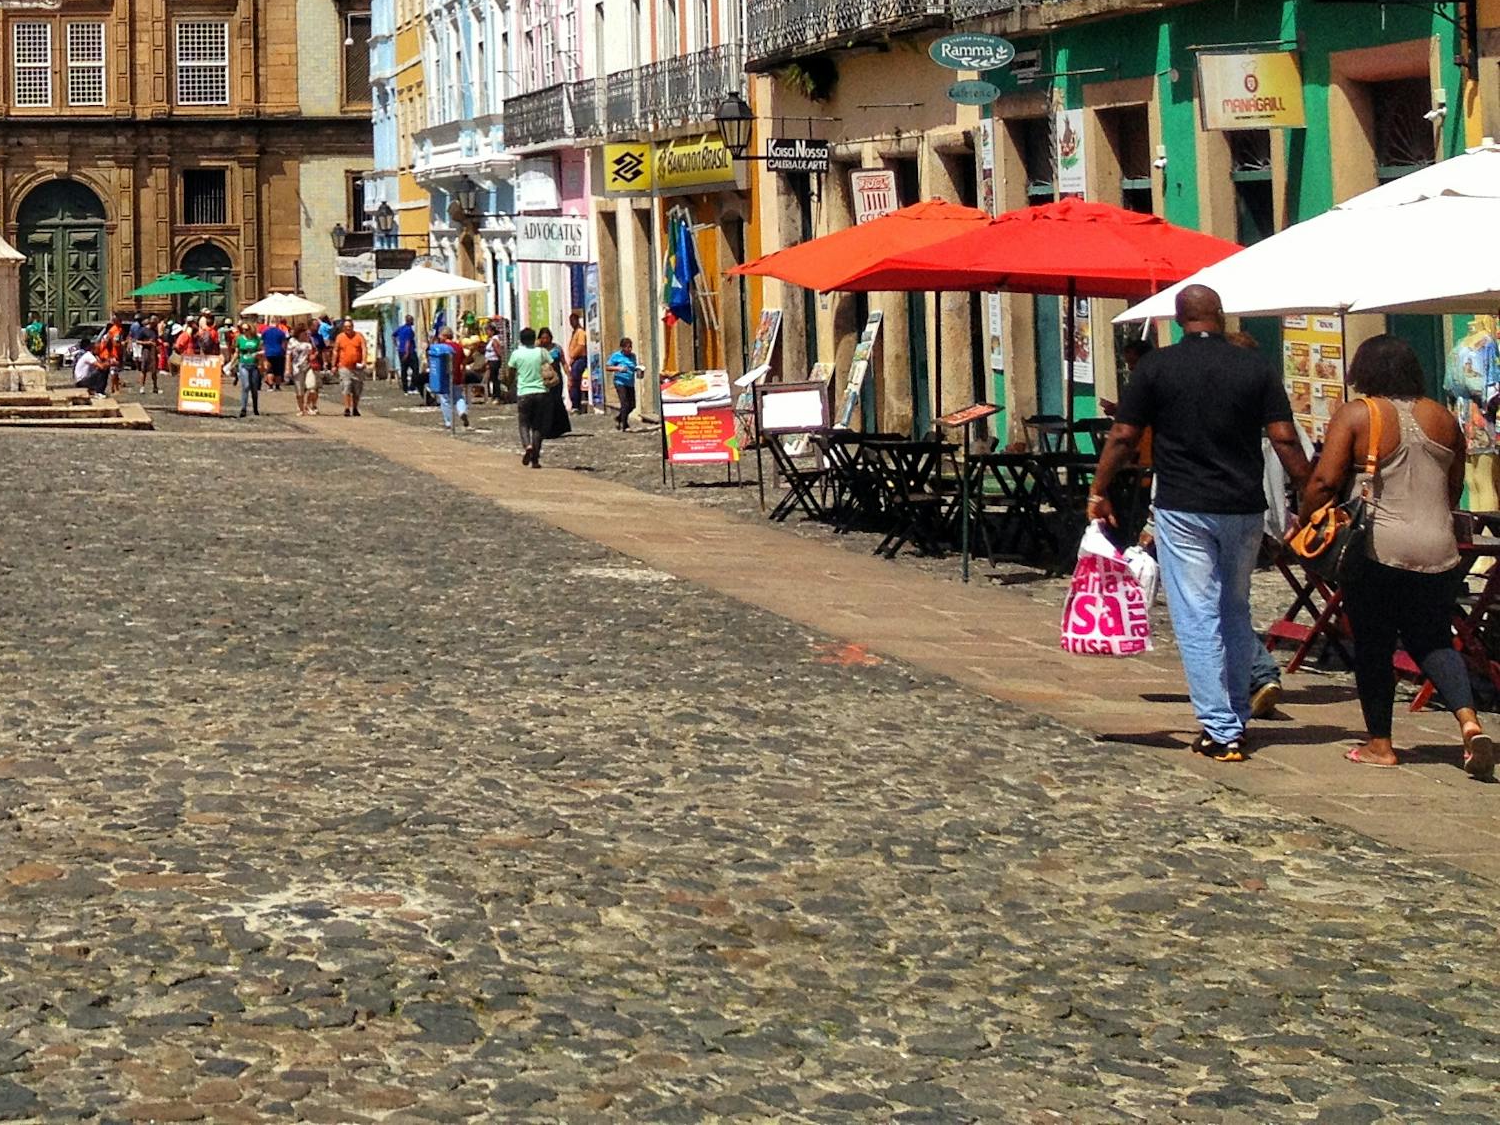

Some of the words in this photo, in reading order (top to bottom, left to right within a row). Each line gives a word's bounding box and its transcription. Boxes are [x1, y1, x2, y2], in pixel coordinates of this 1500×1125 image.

[941, 43, 994, 57] Ramma
[795, 139, 828, 159] Nossa
[702, 146, 729, 170] BRASIL
[768, 160, 798, 170] GALERIA
[809, 161, 828, 170] ARTE
[523, 222, 582, 241] ADVOCATUS
[182, 390, 217, 398] EXCHANGE
